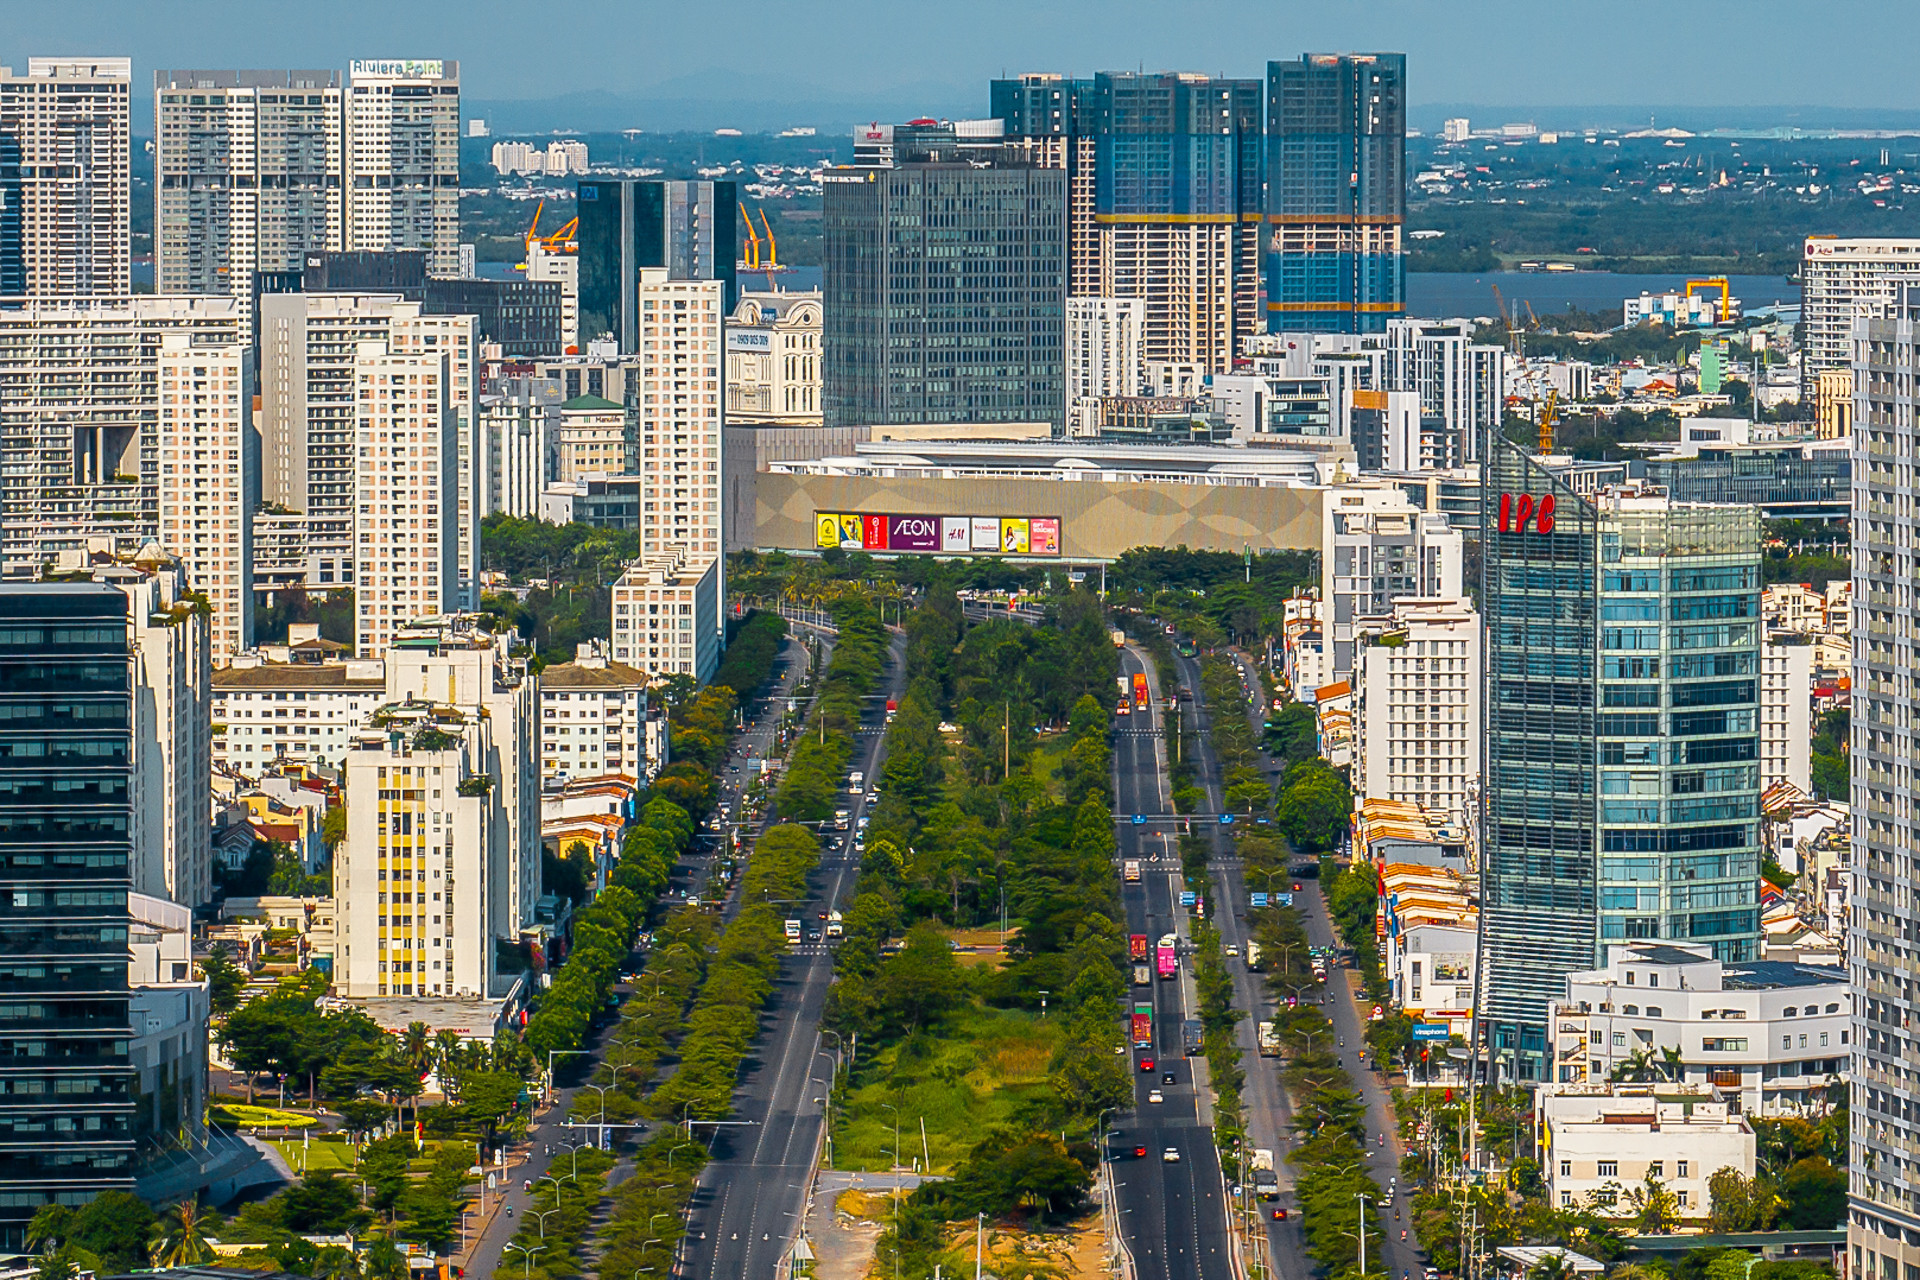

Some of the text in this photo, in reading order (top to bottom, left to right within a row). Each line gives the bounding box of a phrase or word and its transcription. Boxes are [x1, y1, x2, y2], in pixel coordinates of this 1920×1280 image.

[353, 60, 443, 75] Riviera Point
[1498, 493, 1555, 534] IPC
[1414, 1028, 1447, 1036] vinaphone
